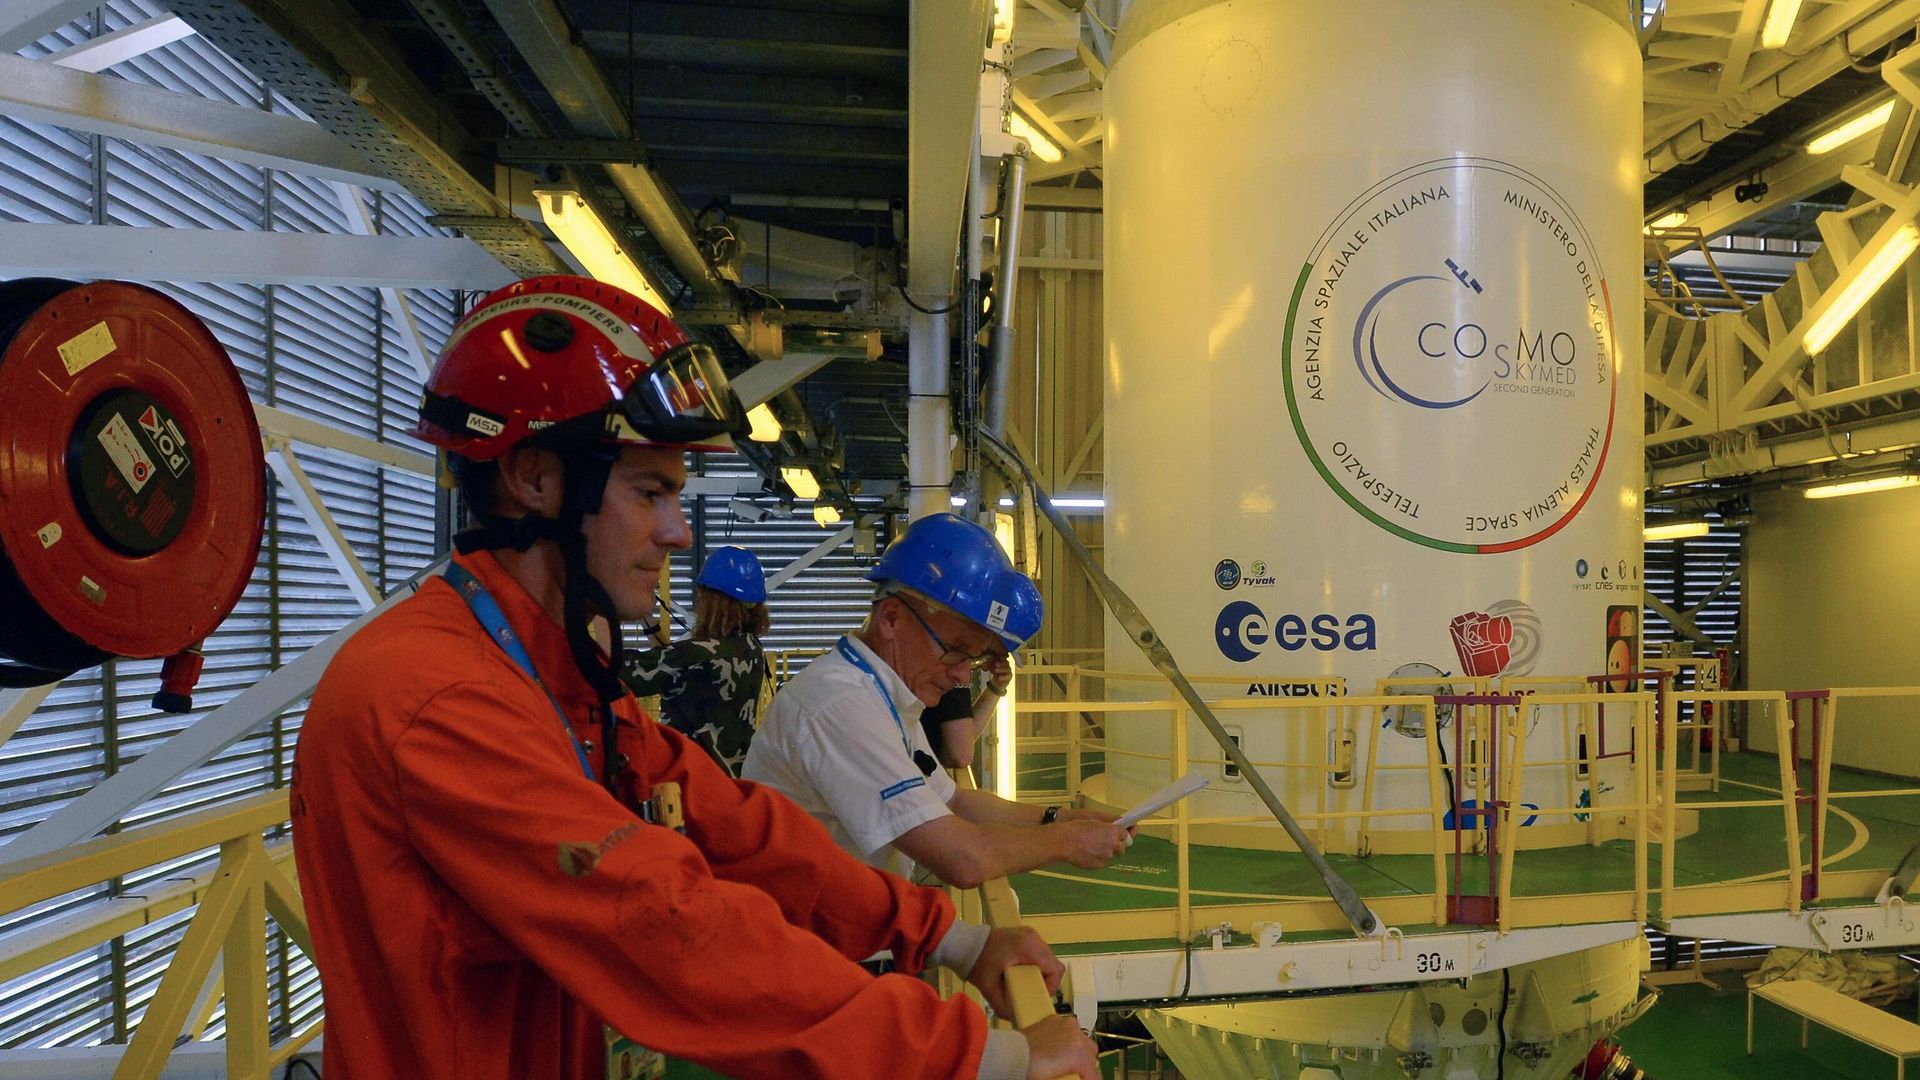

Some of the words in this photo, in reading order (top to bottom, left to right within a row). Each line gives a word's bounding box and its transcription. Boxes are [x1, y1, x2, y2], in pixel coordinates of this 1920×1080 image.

[1367, 185, 1450, 233] ITALIANA
[1314, 230, 1369, 310] SPAZIALE
[1503, 190, 1577, 257] MINISTERO
[1576, 260, 1599, 315] DELLA
[1594, 321, 1606, 384] DIFESA
[462, 296, 624, 336] SAPEURS-POMPIERS
[1305, 315, 1325, 401] AGENZIA
[1494, 383, 1529, 395] SECOND
[1530, 385, 1576, 399] GENERATION
[141, 407, 184, 470] POK
[469, 416, 499, 432] MSA
[1570, 427, 1600, 484] THALES
[1332, 441, 1420, 519] TELESPAZIO
[1522, 481, 1569, 521] ALENIA
[1465, 513, 1519, 532] SPACE
[1243, 576, 1276, 587] Tyvak
[1275, 613, 1377, 652] esa
[1030, 653, 1037, 666] 1
[1706, 664, 1718, 684] 4
[1841, 924, 1863, 943] 30
[1416, 952, 1441, 974] 30
